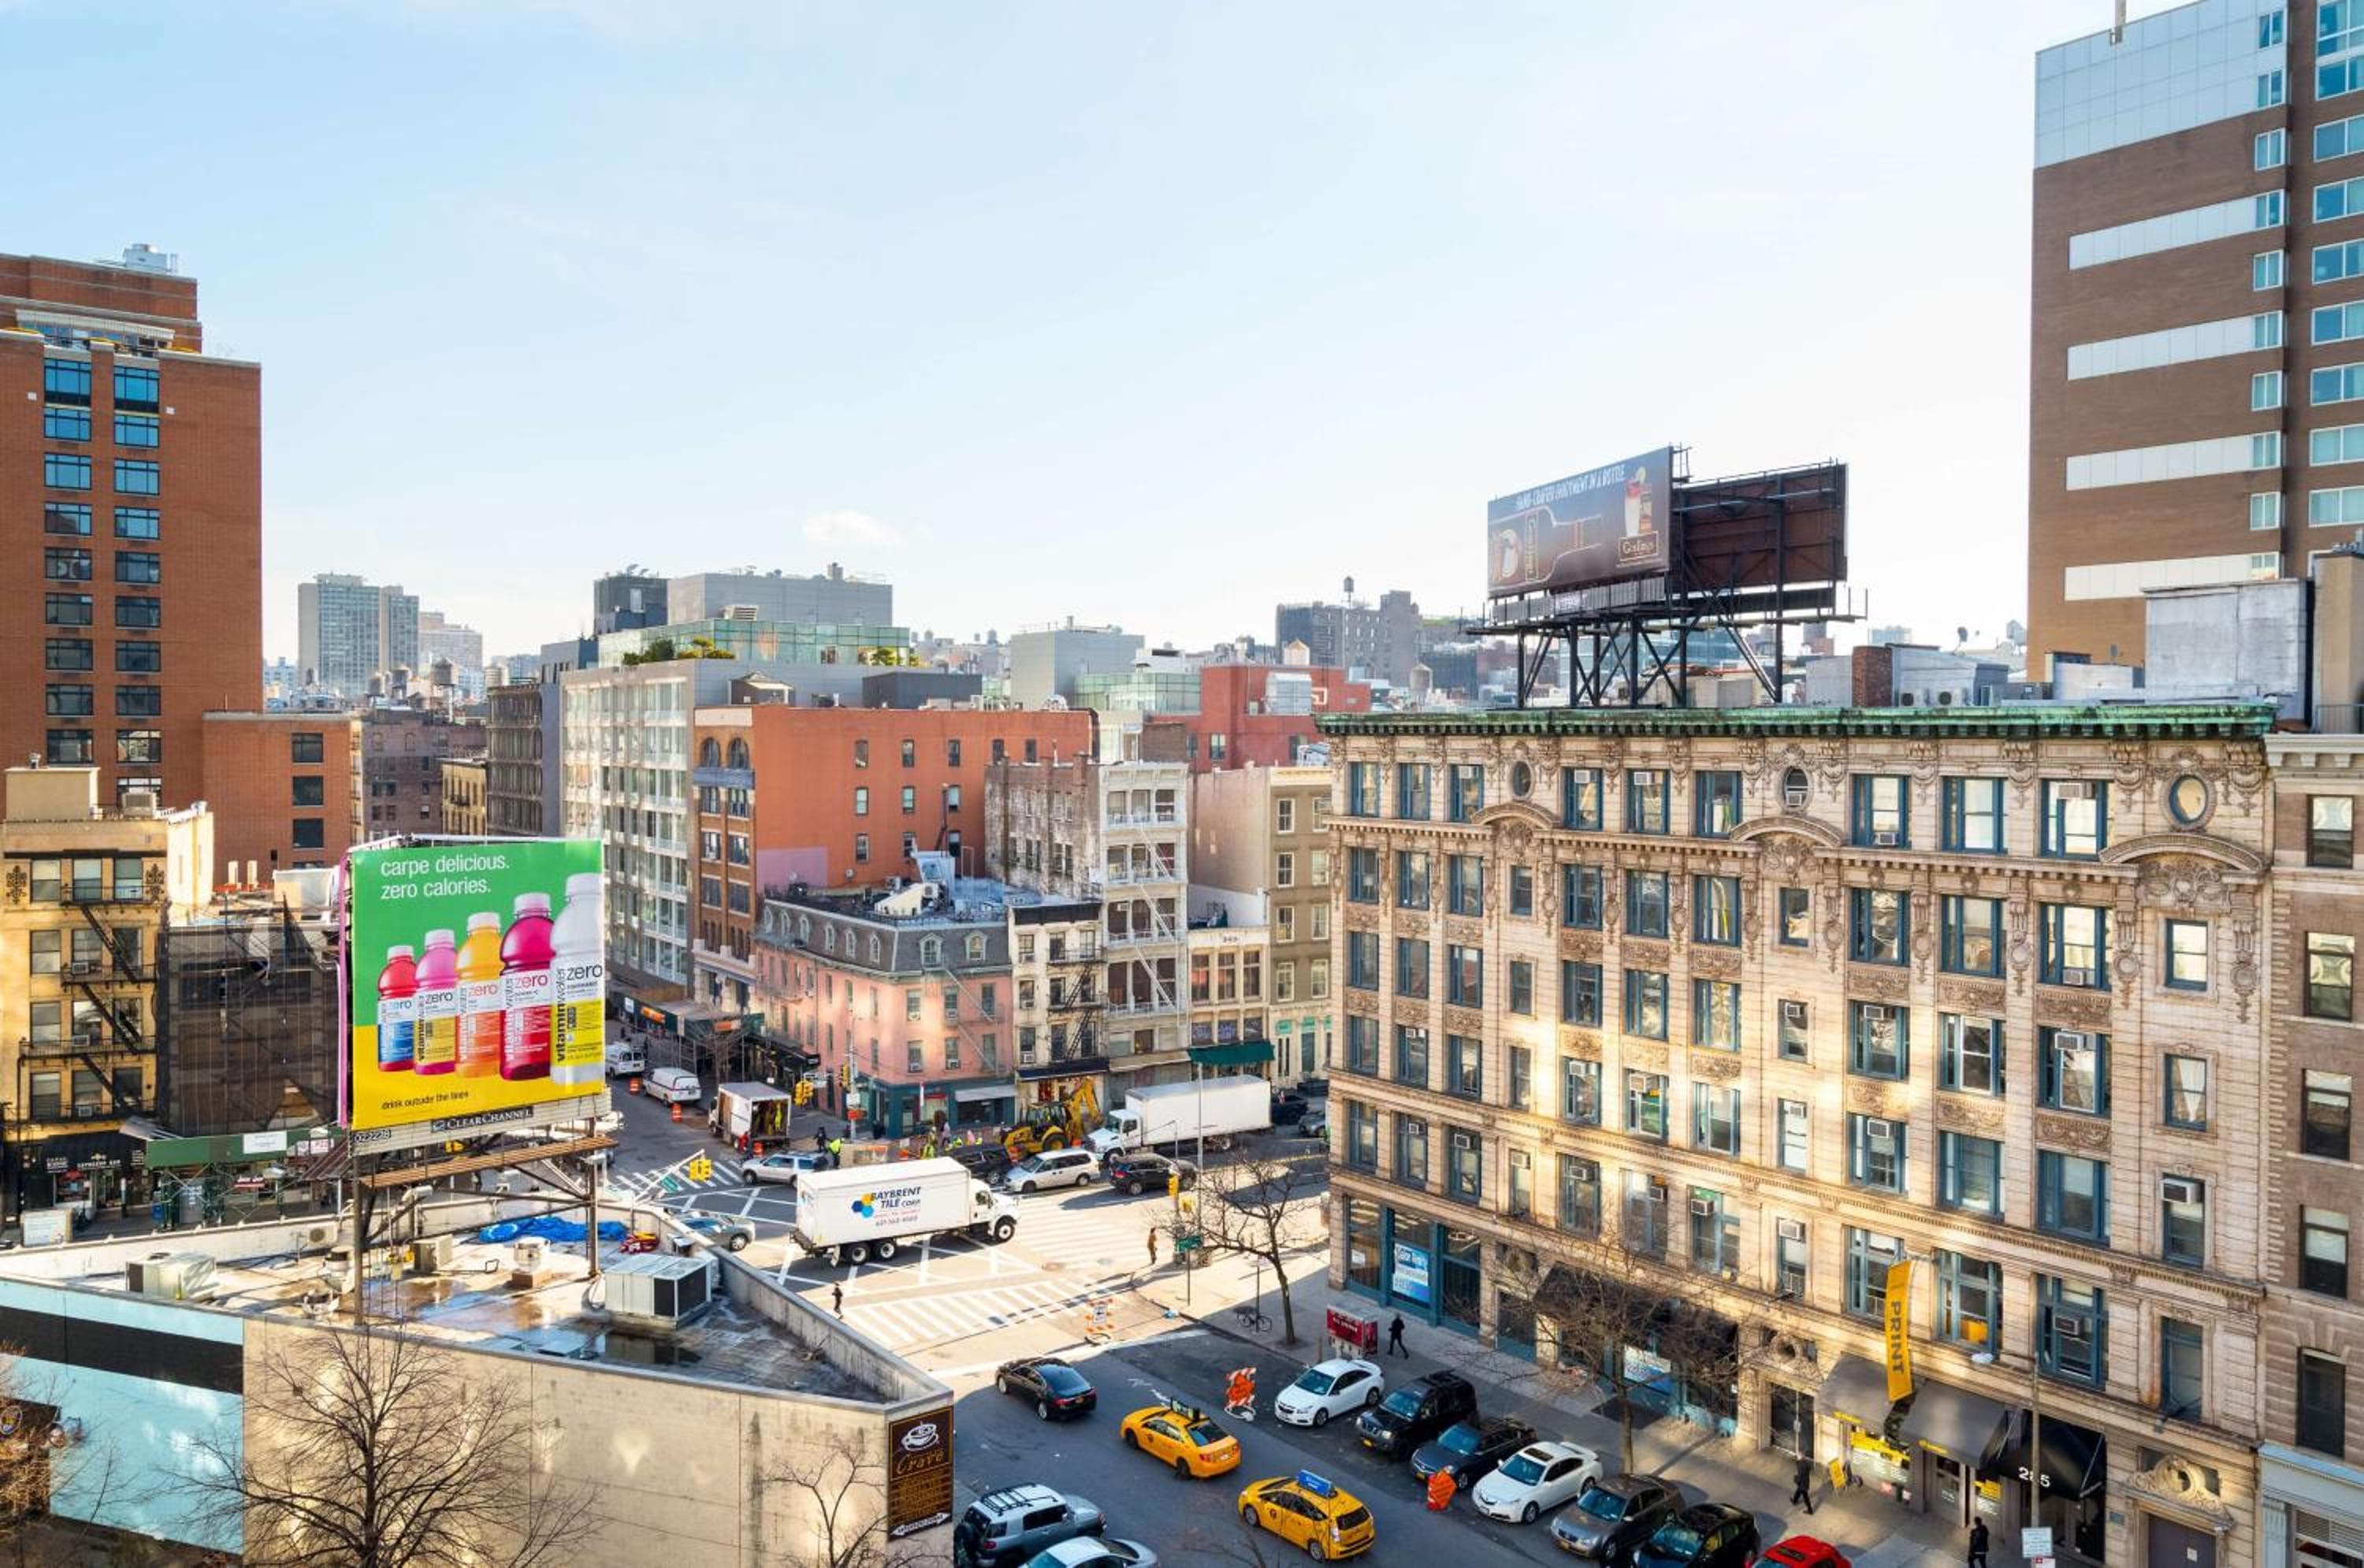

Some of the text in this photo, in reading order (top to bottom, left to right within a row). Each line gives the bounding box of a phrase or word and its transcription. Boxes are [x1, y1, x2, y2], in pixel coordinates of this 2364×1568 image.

[381, 853, 510, 879] carpe delicious.
[381, 877, 492, 900] zero calories.
[567, 964, 603, 981] zero
[515, 974, 548, 989] zero
[426, 992, 453, 1005] zero
[436, 1092, 449, 1102] the
[881, 1198, 901, 1209] TILE
[1890, 1301, 1905, 1375] PRINT
